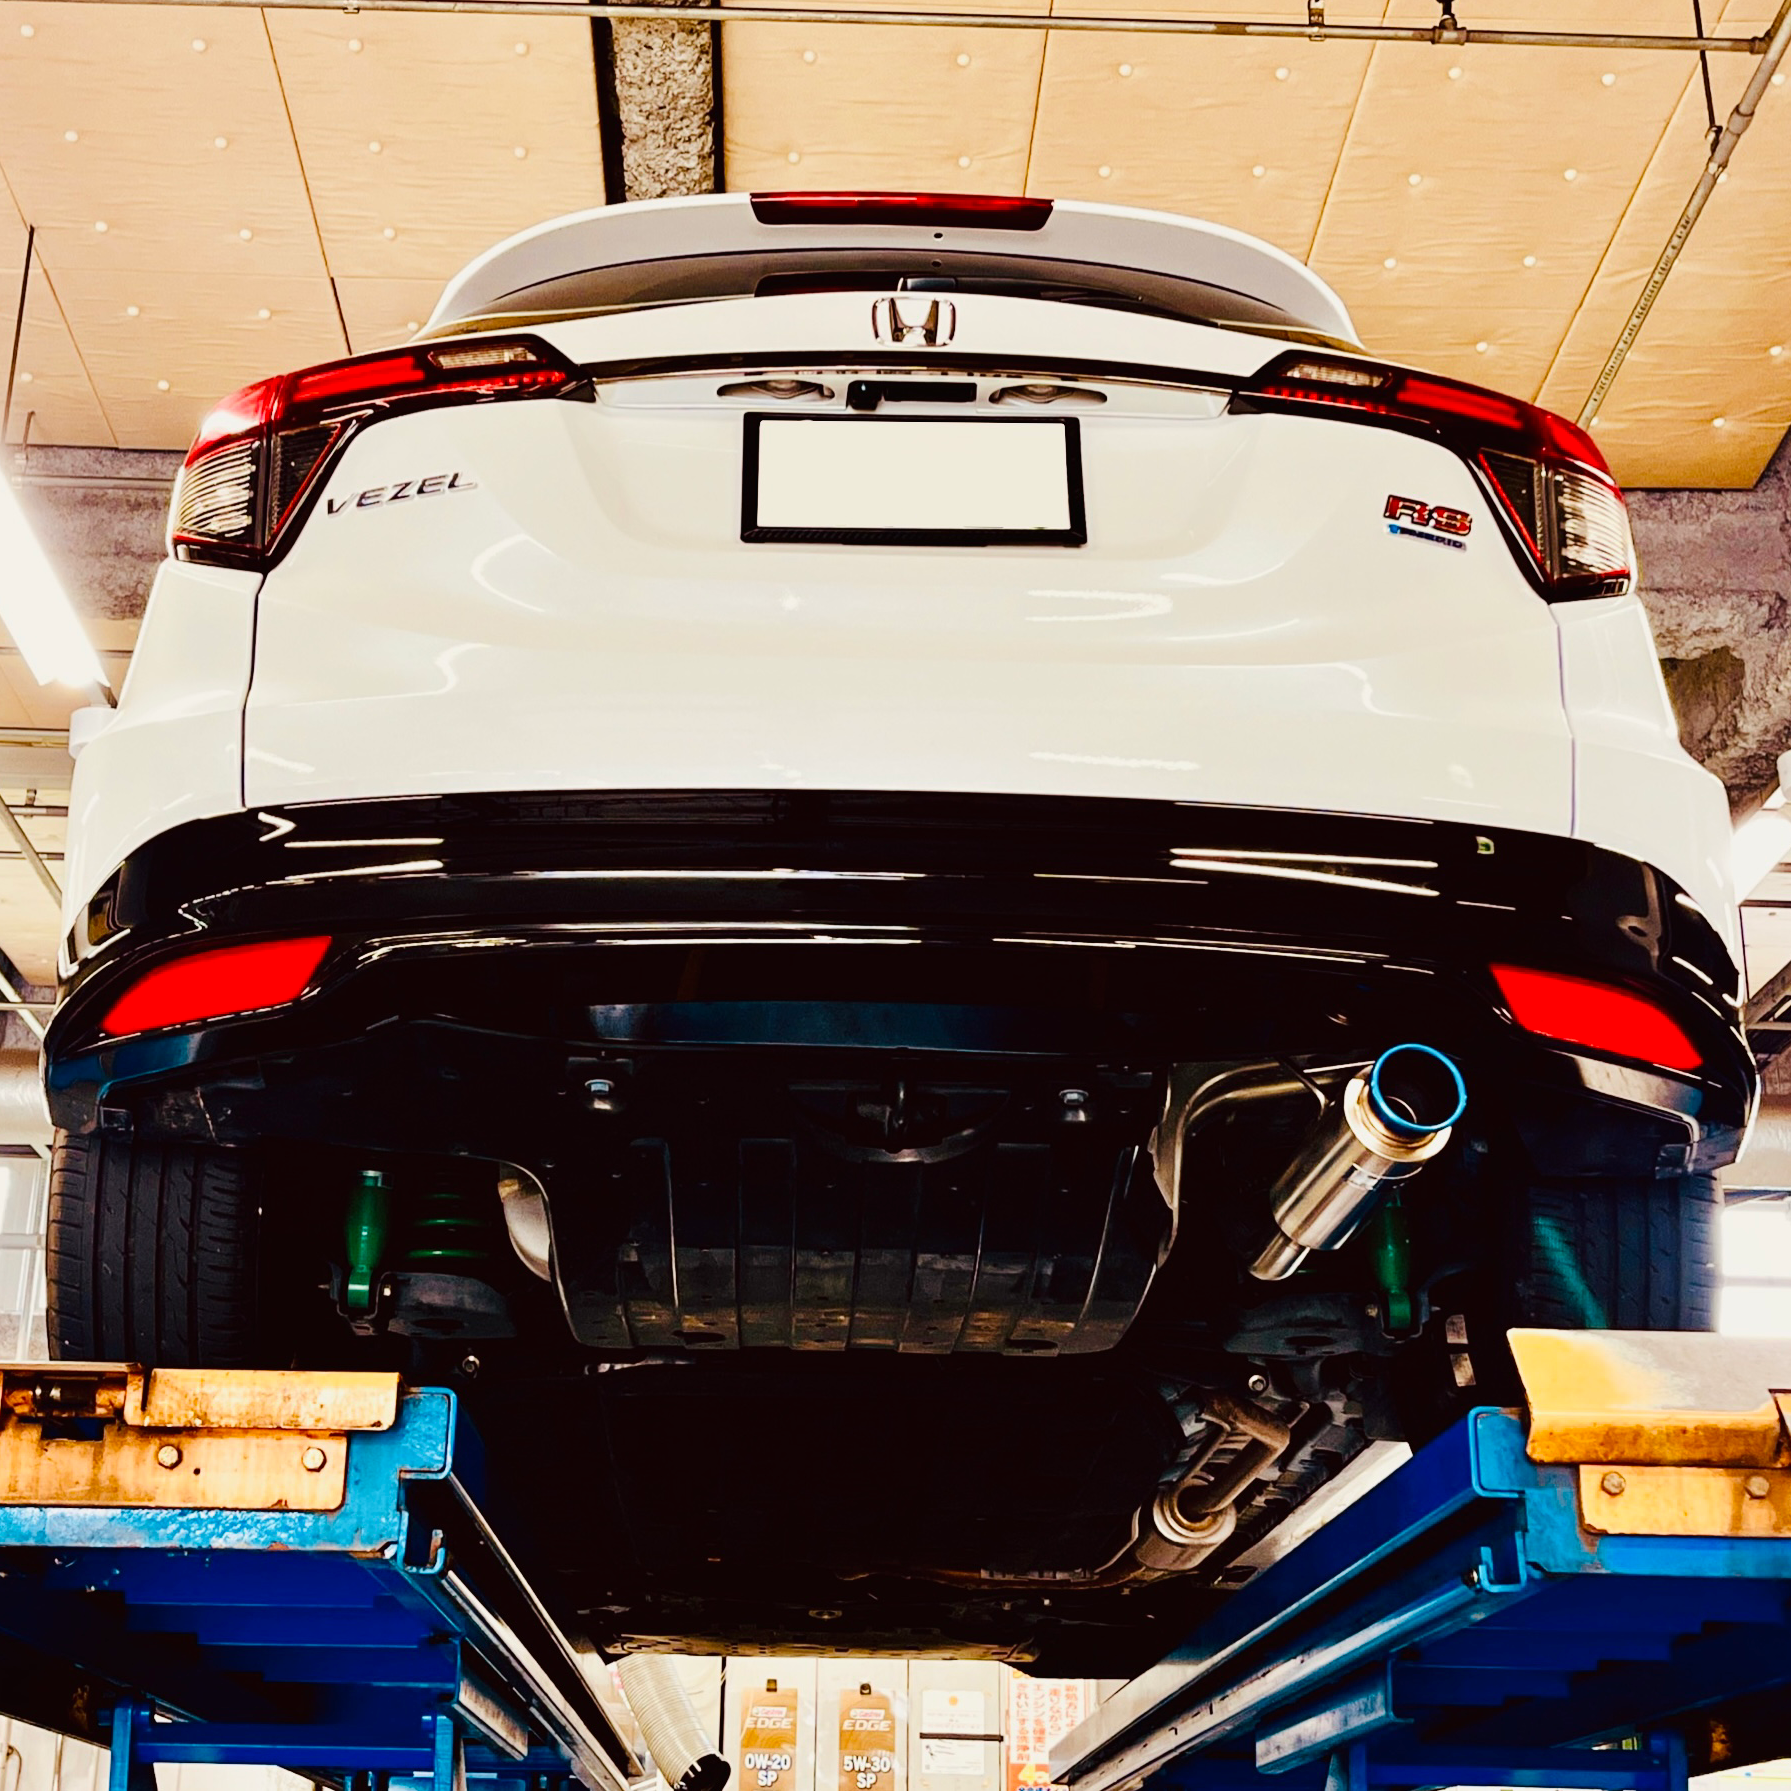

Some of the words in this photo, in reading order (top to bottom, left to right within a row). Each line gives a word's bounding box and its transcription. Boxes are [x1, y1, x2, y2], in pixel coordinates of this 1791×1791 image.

[326, 472, 477, 516] VEZEL
[1383, 494, 1473, 537] RS
[746, 1717, 793, 1729] EDGE
[842, 1719, 892, 1731] EDGE
[744, 1753, 792, 1771] 0W-20
[843, 1755, 891, 1773] 5W-30
[757, 1769, 779, 1787] SP
[856, 1771, 877, 1789] SP
